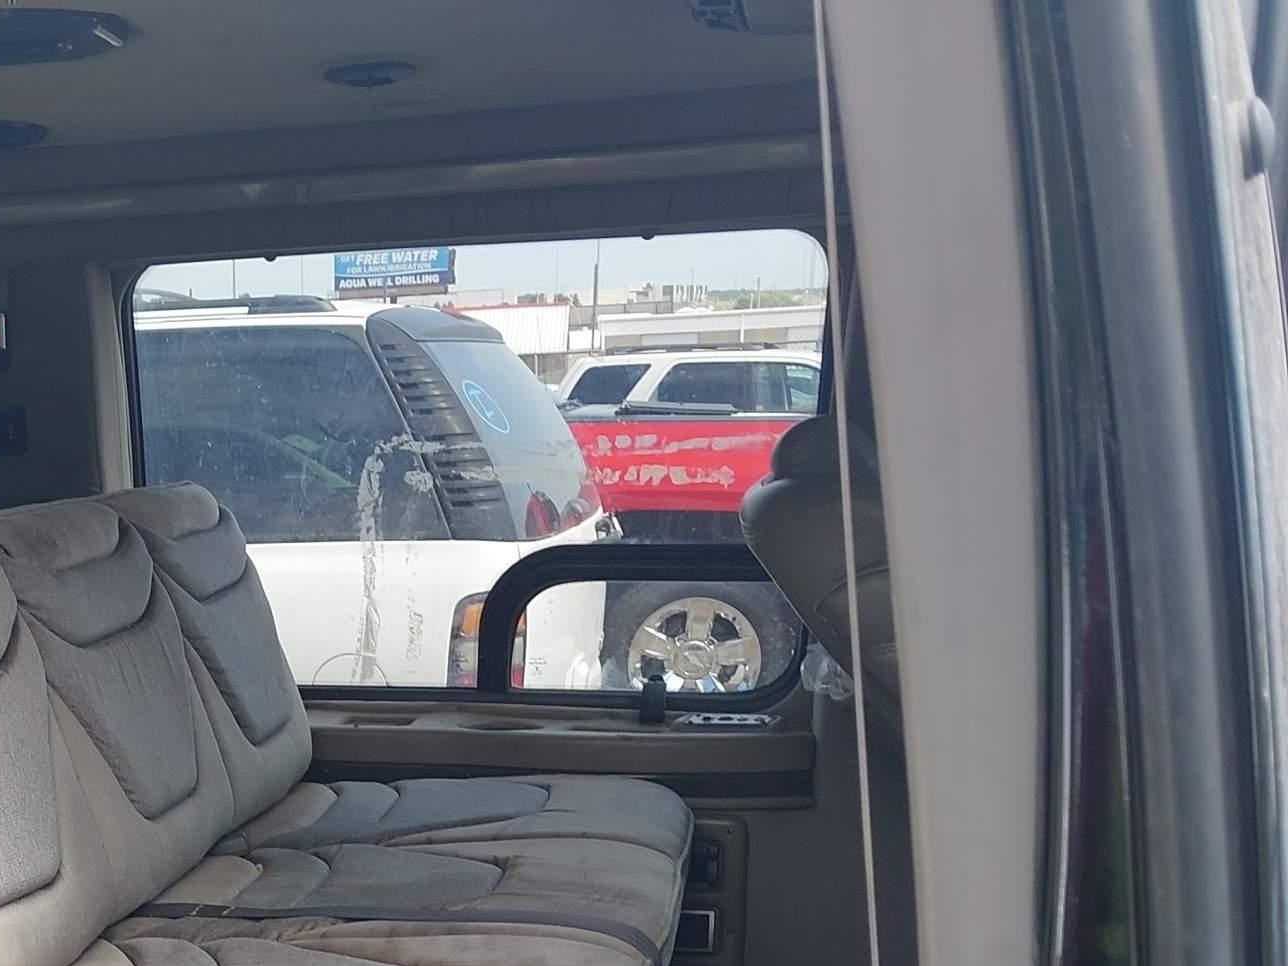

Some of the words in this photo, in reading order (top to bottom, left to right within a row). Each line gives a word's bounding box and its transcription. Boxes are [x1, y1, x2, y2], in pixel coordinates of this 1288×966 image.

[356, 252, 389, 265] FREE
[392, 249, 438, 263] WATER
[347, 266, 363, 274] FOR
[364, 265, 386, 273] LAWN
[387, 263, 431, 272] IRRIGATION
[339, 278, 366, 289] AQUA
[368, 277, 393, 287] WEL
[395, 274, 440, 286] DRILLING
